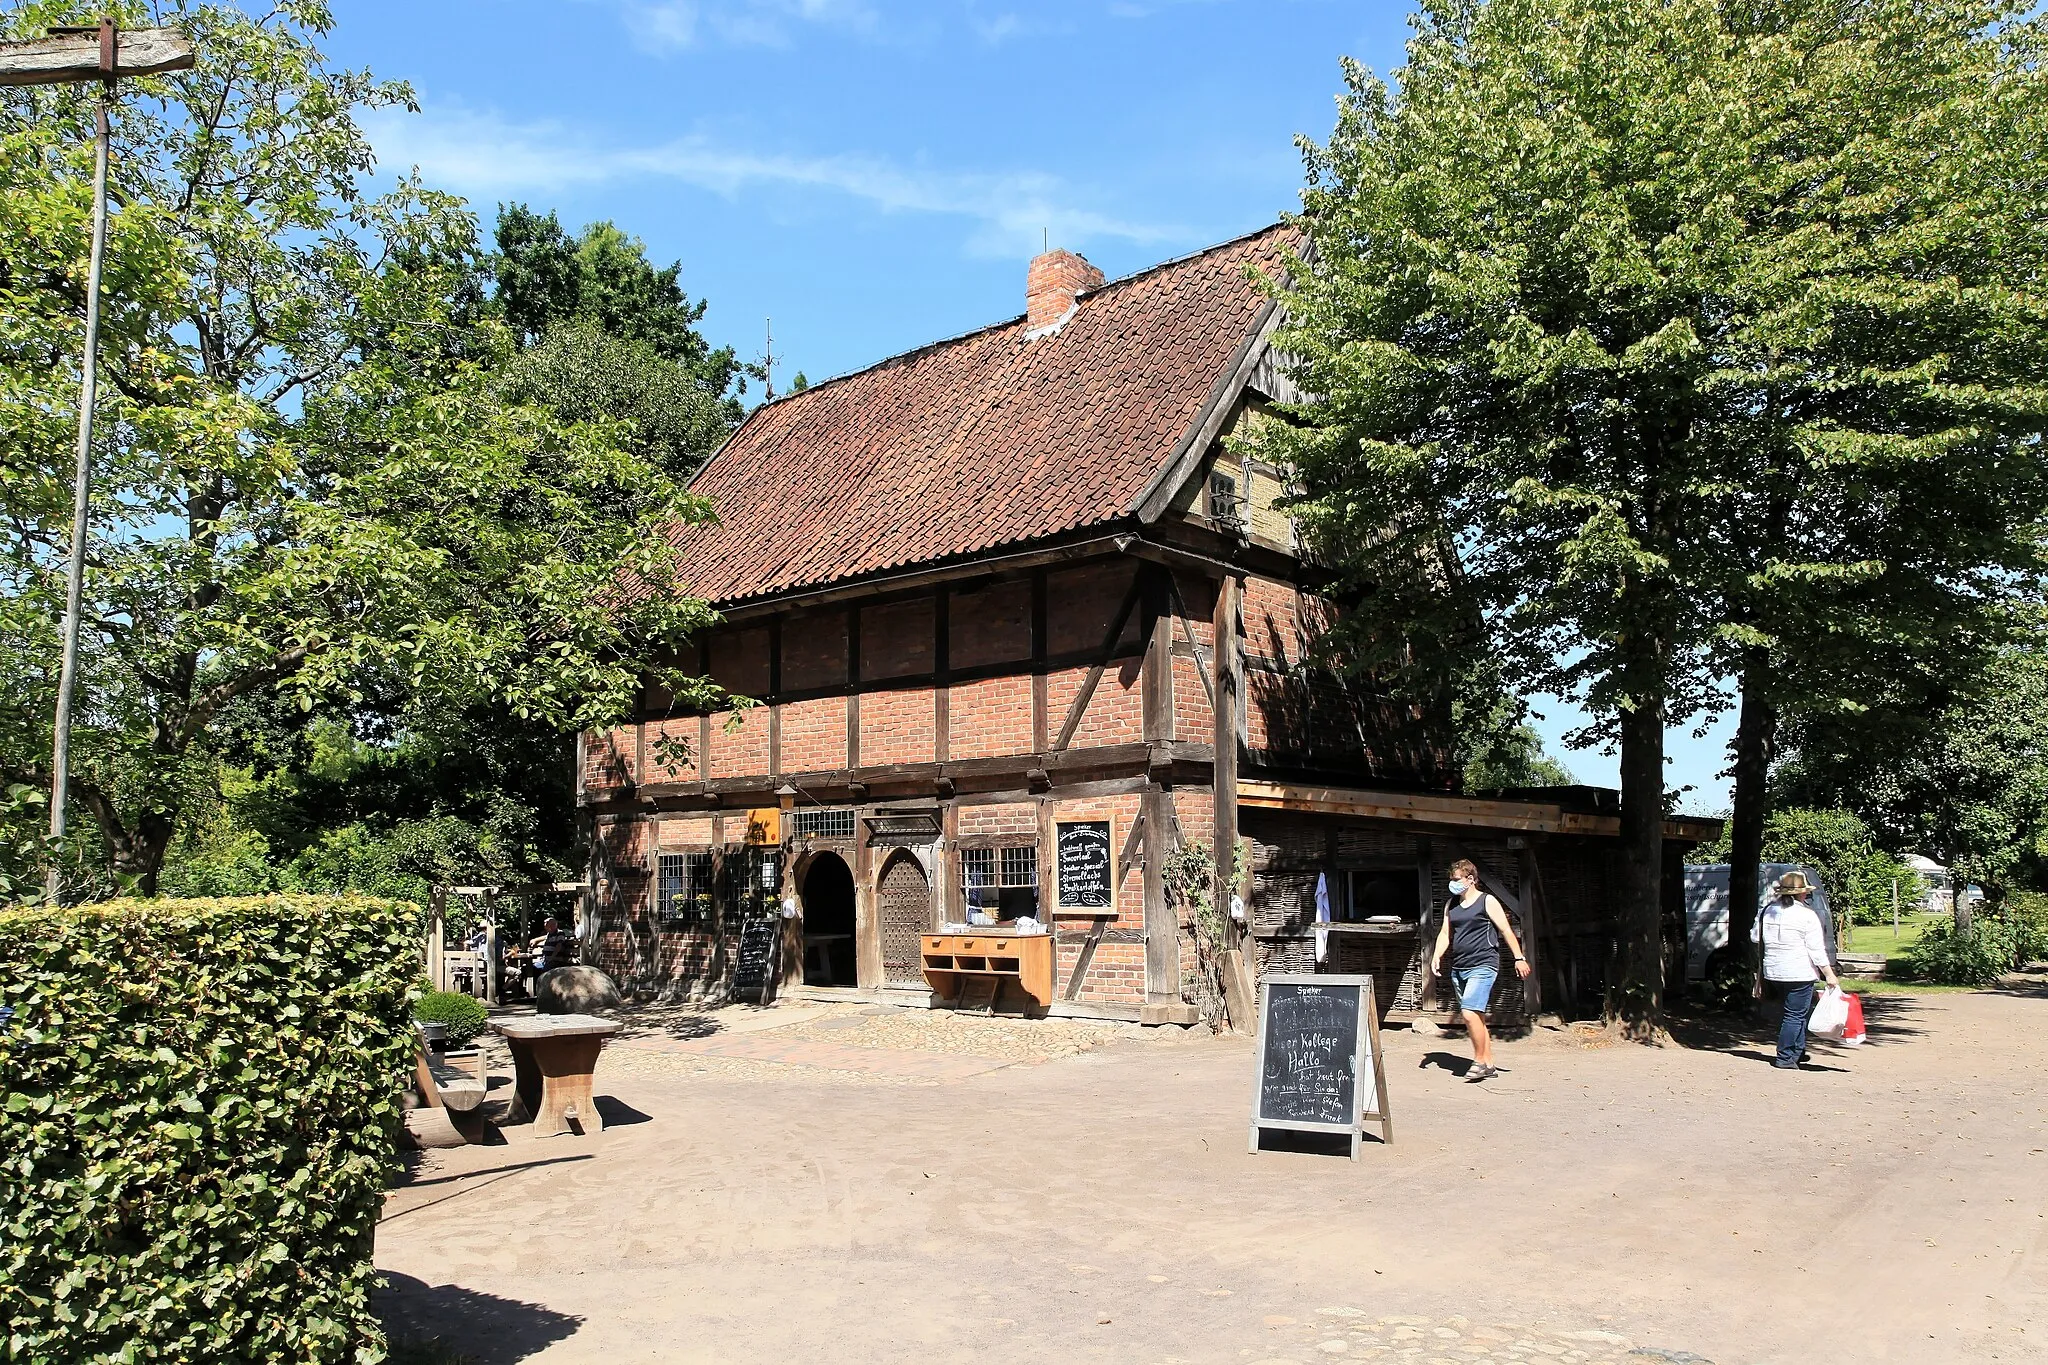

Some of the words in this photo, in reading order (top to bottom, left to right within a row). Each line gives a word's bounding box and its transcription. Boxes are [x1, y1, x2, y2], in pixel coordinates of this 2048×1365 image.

[1300, 1032, 1338, 1053] Kollege
[1287, 1050, 1320, 1073] Hallo
[1322, 1095, 1343, 1111] Stefan
